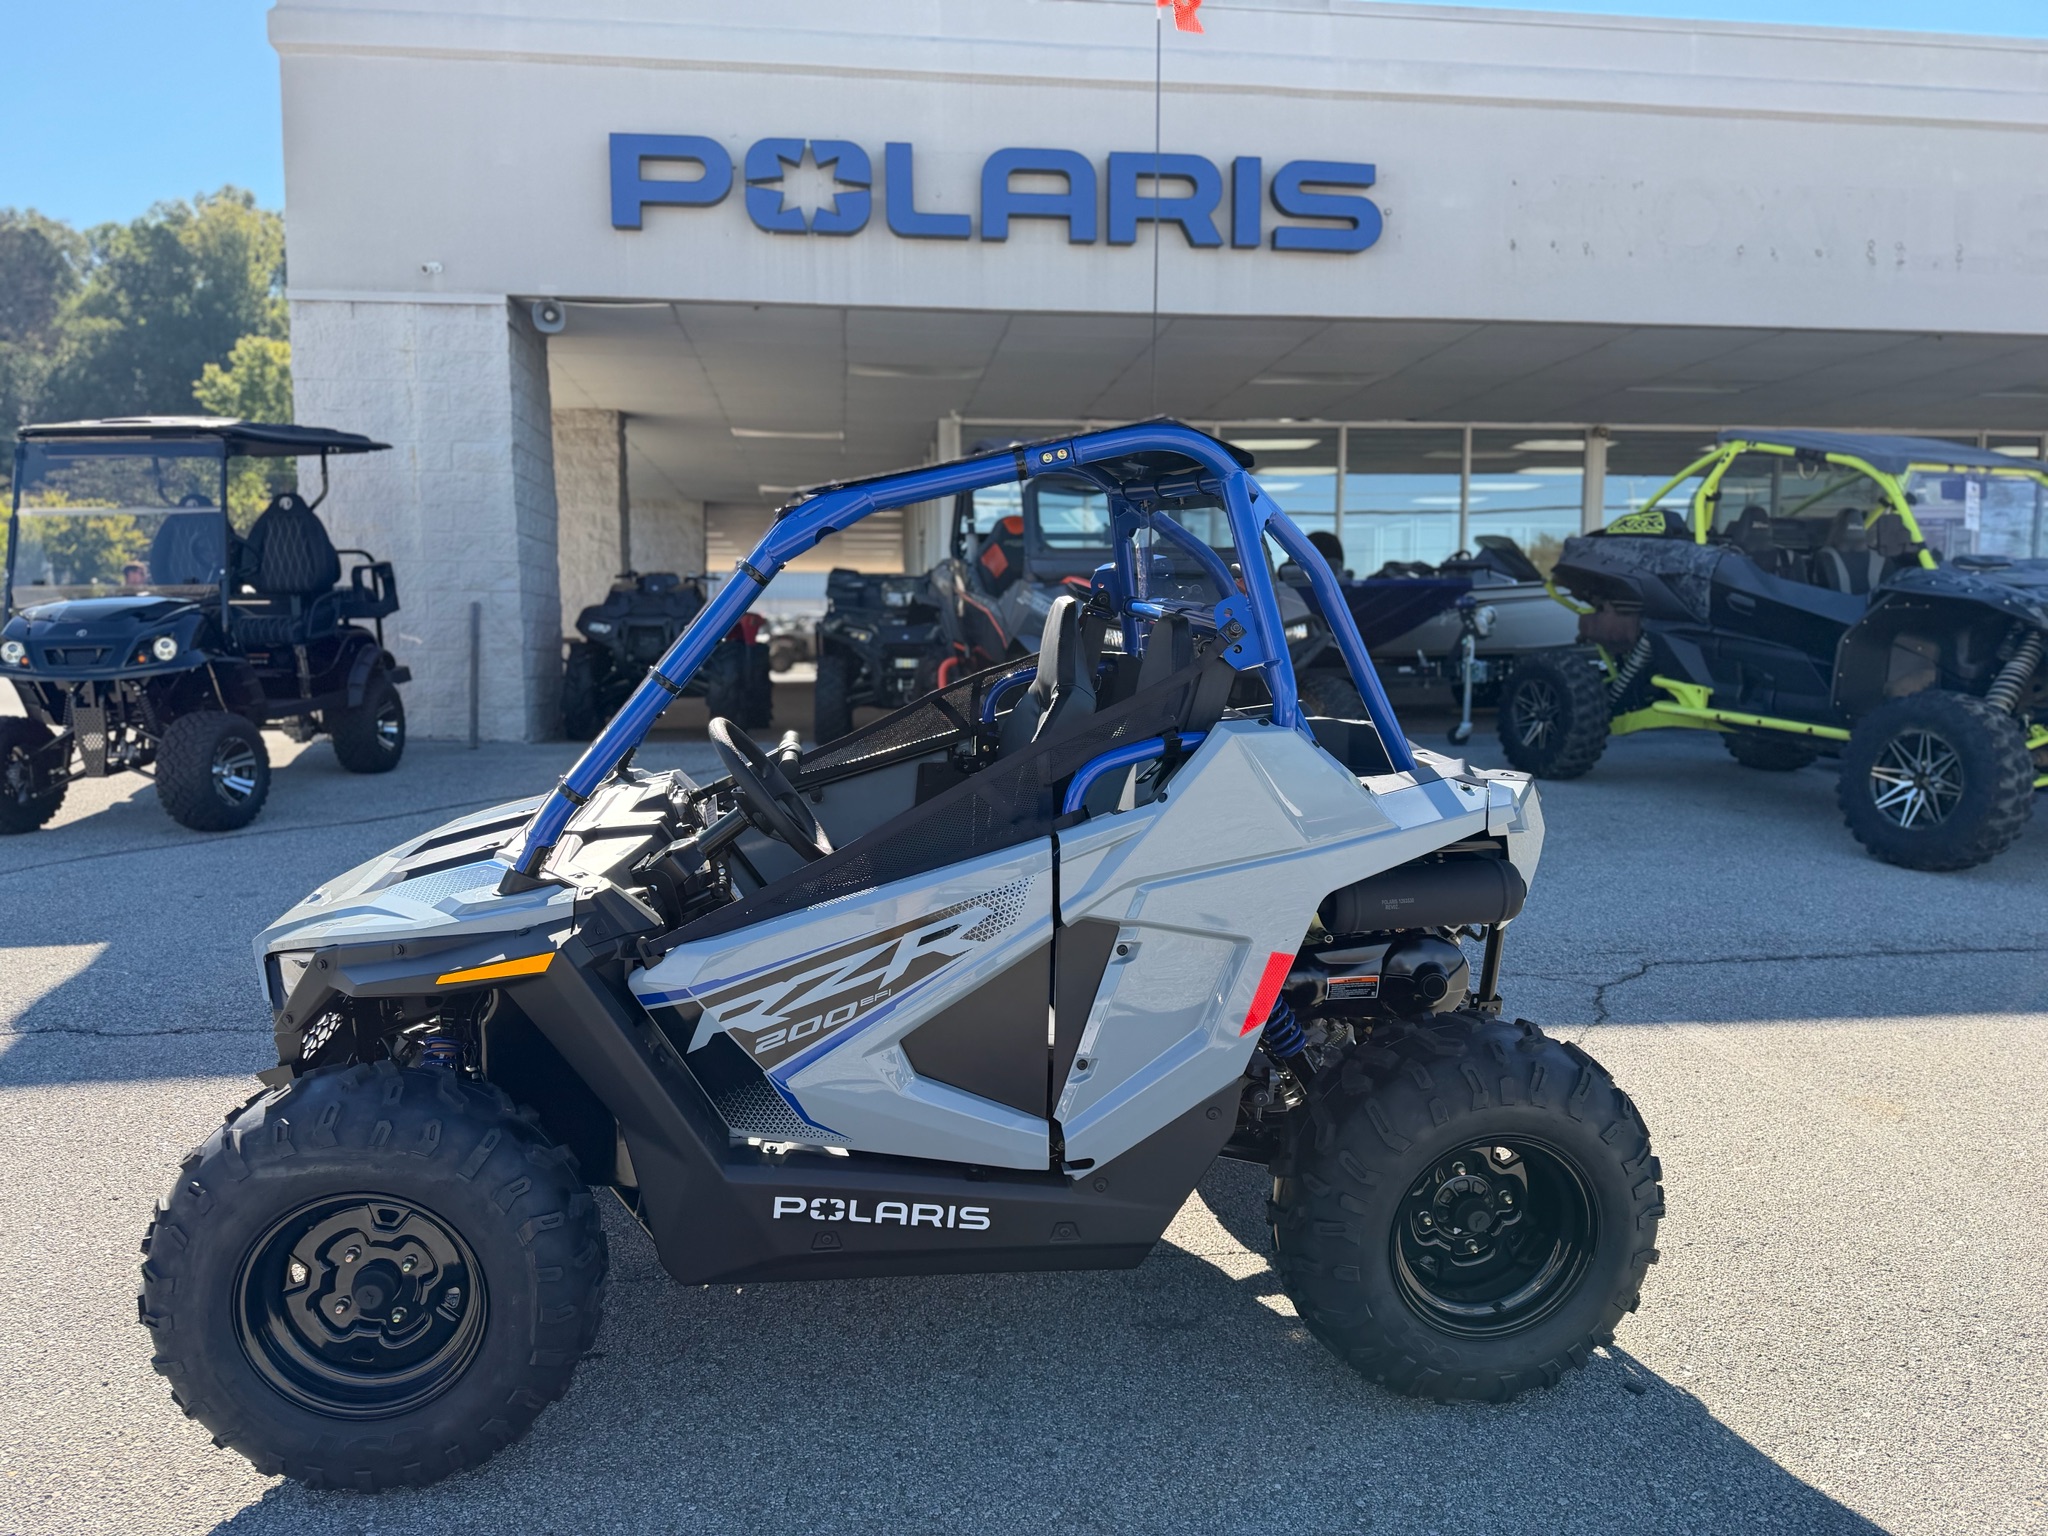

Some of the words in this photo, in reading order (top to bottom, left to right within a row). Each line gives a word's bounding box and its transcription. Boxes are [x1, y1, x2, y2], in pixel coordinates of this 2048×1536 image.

[609, 132, 1383, 253] POLARIS
[686, 906, 996, 1054] RZR
[754, 1002, 858, 1055] 200
[859, 988, 892, 1007] EFI
[773, 1196, 991, 1231] POLARIS
